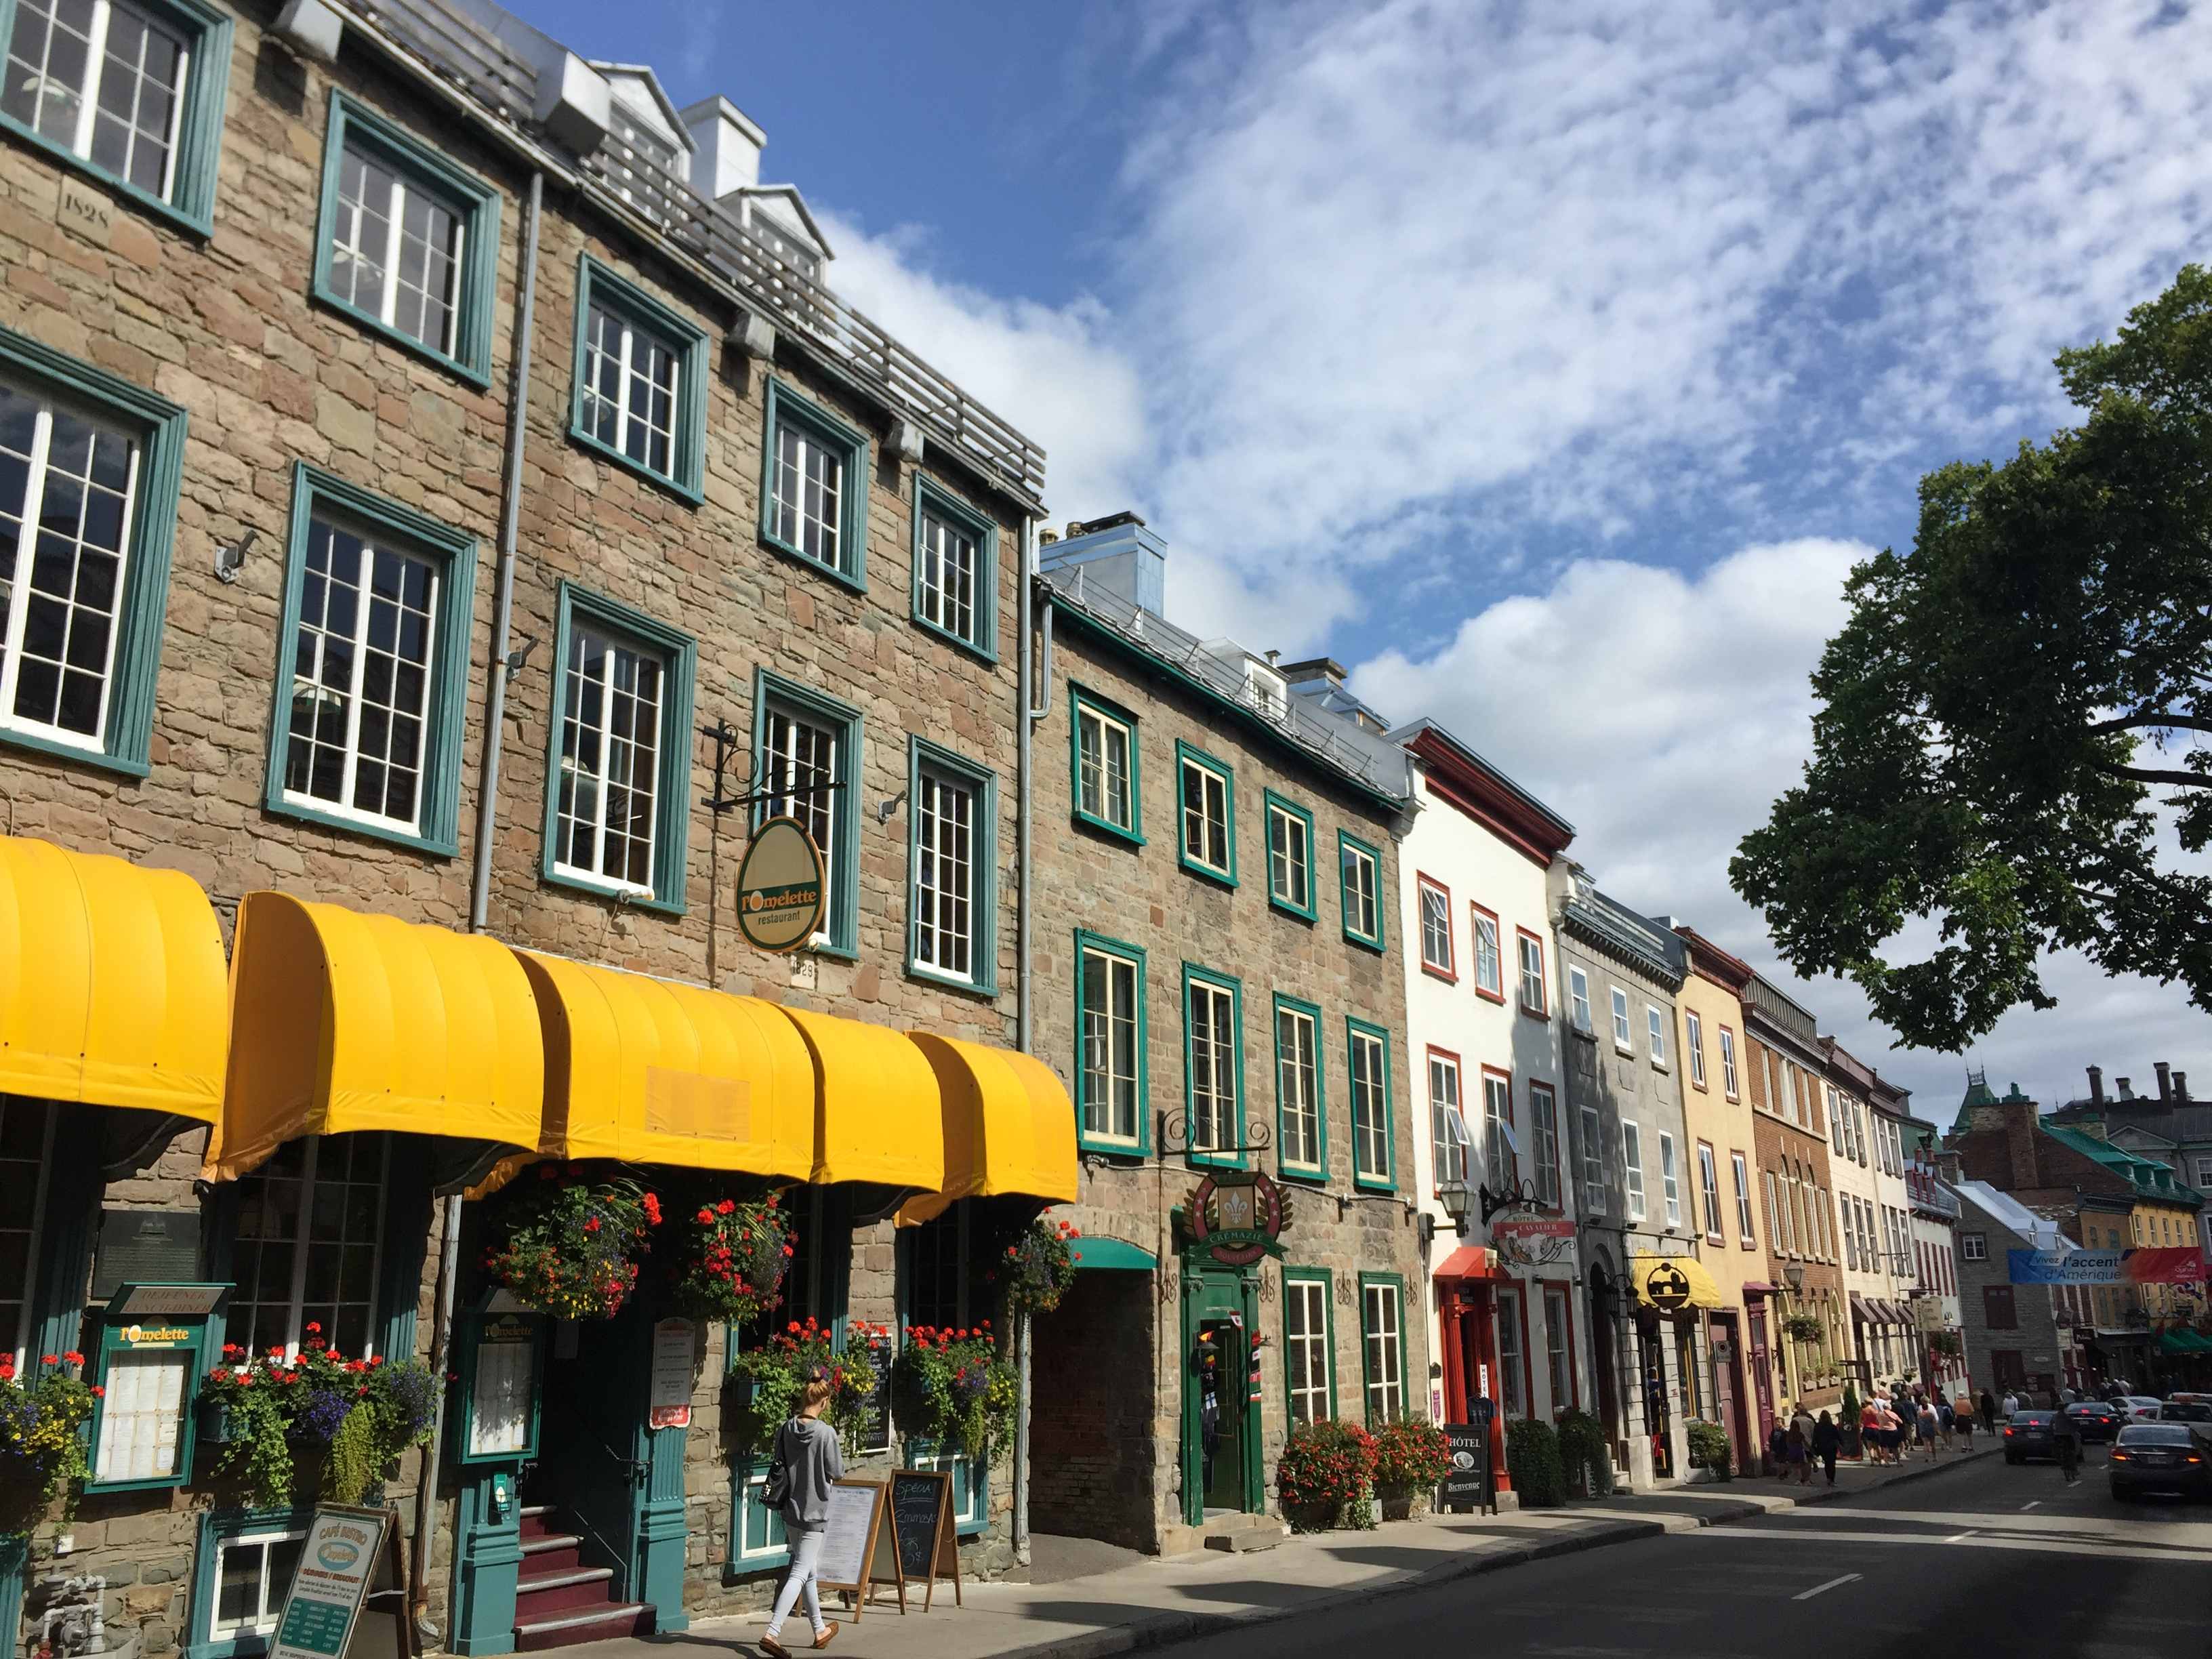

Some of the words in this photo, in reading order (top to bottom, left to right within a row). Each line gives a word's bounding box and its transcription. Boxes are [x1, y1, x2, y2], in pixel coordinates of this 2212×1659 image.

[758, 910, 800, 926] restaurant
[792, 961, 813, 977] 1829
[1209, 1231, 1264, 1243] CRÉMAZIE
[2062, 1256, 2120, 1268] l'accent
[2045, 1268, 2122, 1283] d'Amérique
[1449, 1437, 1481, 1448] HÔTEL
[1448, 1481, 1480, 1492] Bienvenue
